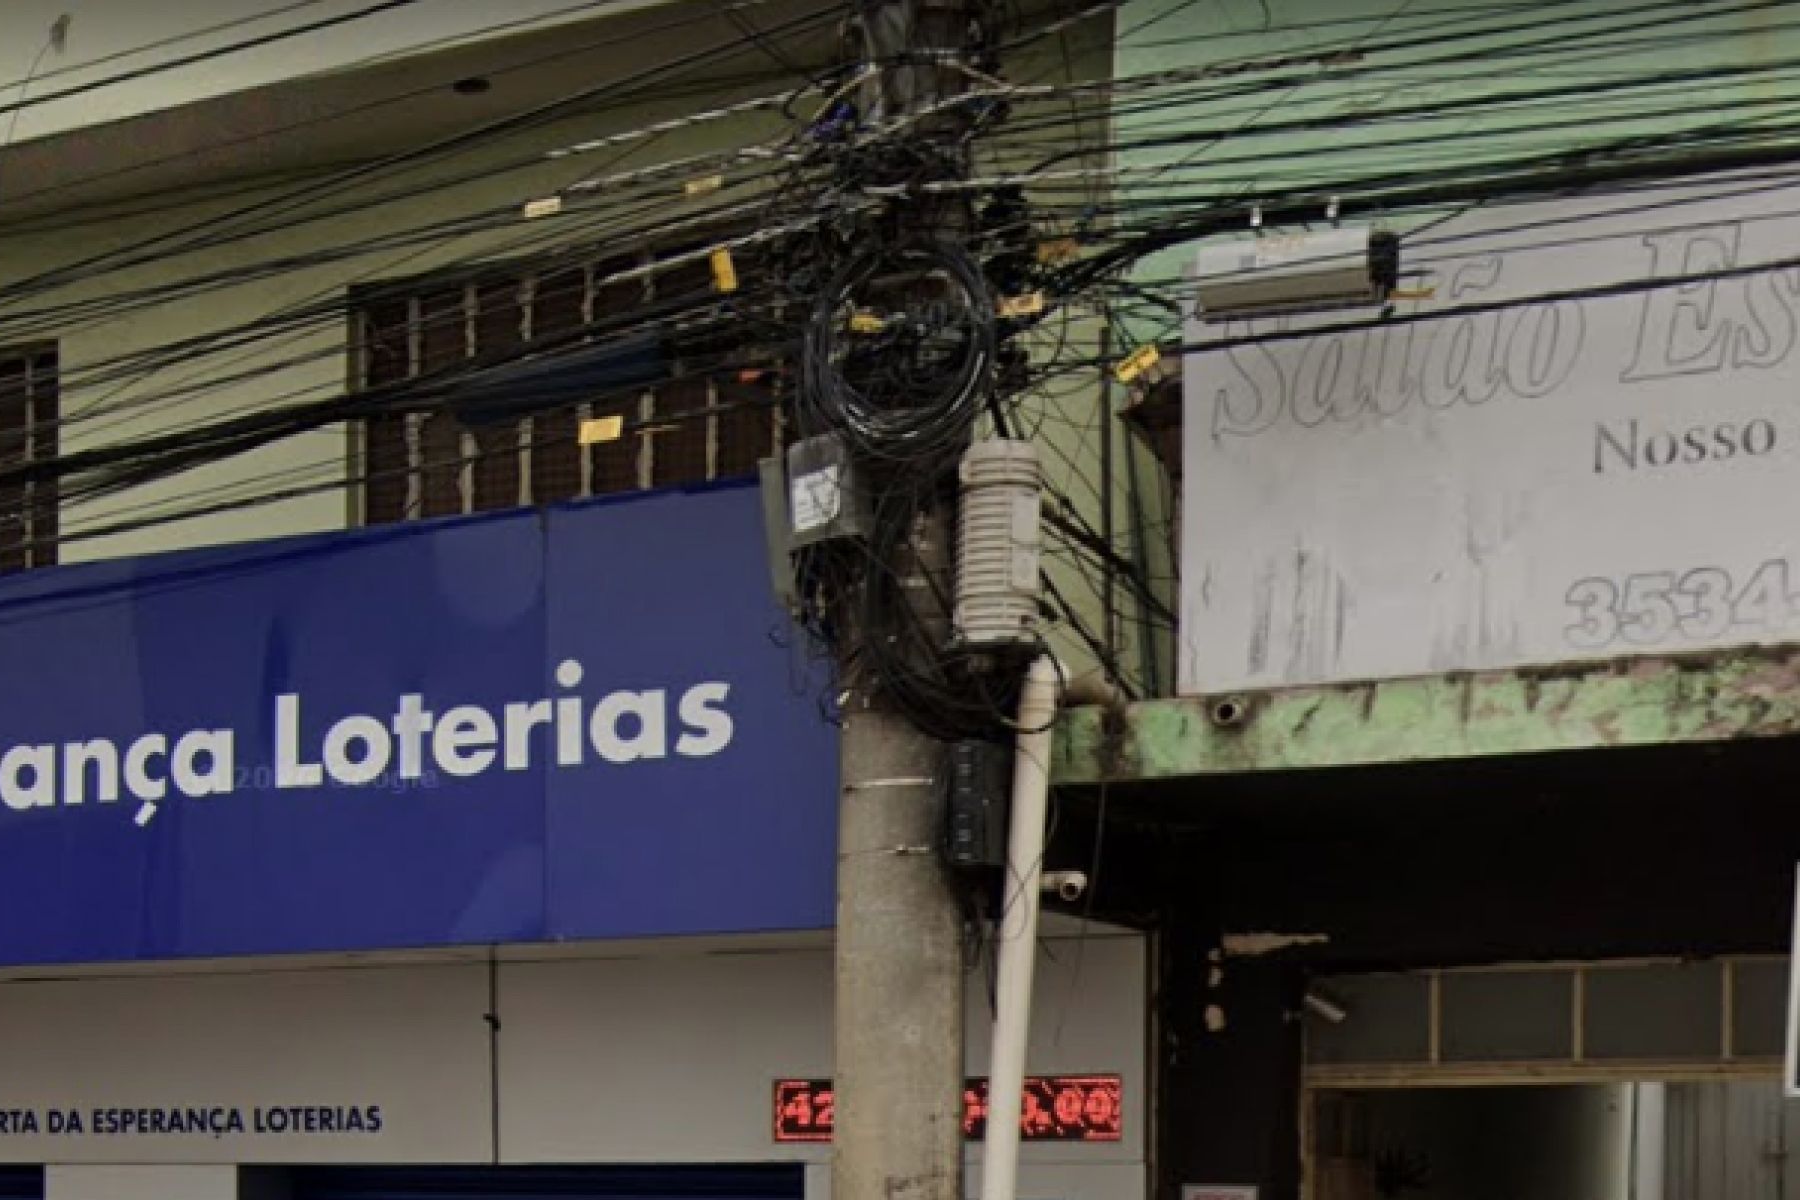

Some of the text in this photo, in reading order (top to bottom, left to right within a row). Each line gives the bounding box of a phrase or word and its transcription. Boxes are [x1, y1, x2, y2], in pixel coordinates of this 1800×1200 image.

[1618, 219, 1800, 386] Es
[1592, 417, 1778, 475] Nosso
[274, 658, 735, 791] Loterias
[46, 1109, 84, 1135] DA
[92, 1105, 245, 1140] ESPERANÇA
[253, 1105, 383, 1133] LOTERIAS
